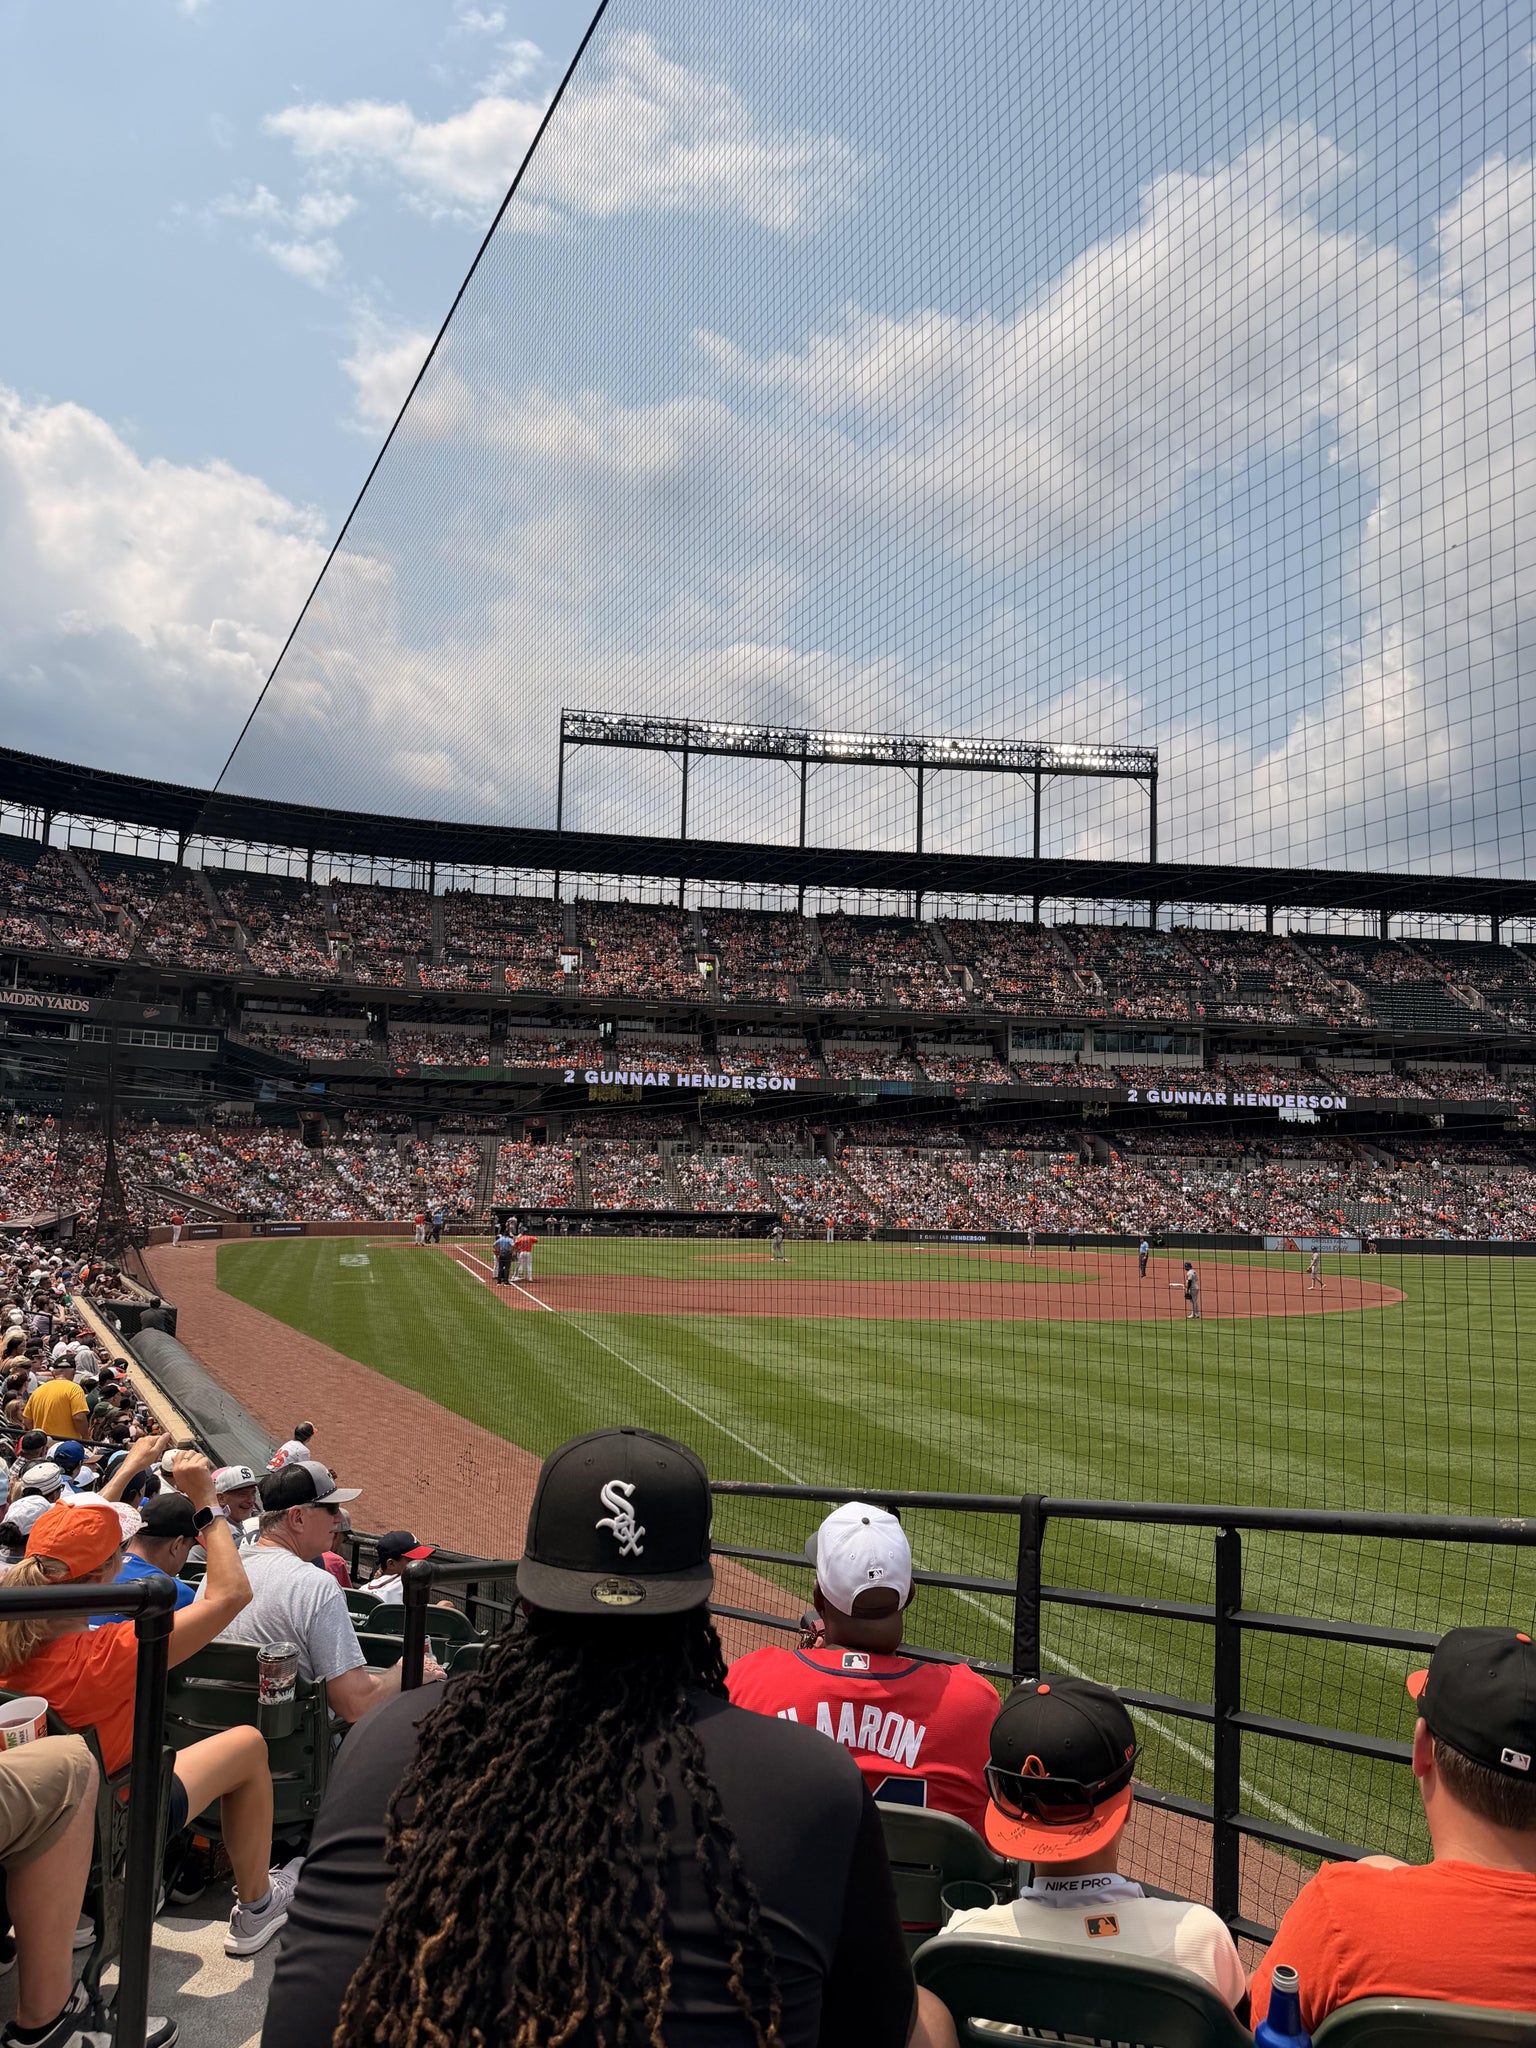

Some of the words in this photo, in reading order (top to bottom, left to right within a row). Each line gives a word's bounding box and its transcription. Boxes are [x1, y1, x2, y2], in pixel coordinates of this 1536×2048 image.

[45, 997, 90, 1012] YARDS
[564, 1070, 575, 1083] 2
[584, 1071, 670, 1086] GUNNAR
[677, 1073, 796, 1091] HENDERSON
[1127, 1089, 1138, 1102] 2
[1147, 1090, 1227, 1105] GUNNAR
[1234, 1093, 1347, 1109] HENDERSON
[816, 1701, 927, 1769] AARON
[1045, 1881, 1079, 1891] NIKE
[1081, 1877, 1112, 1889] PRO
